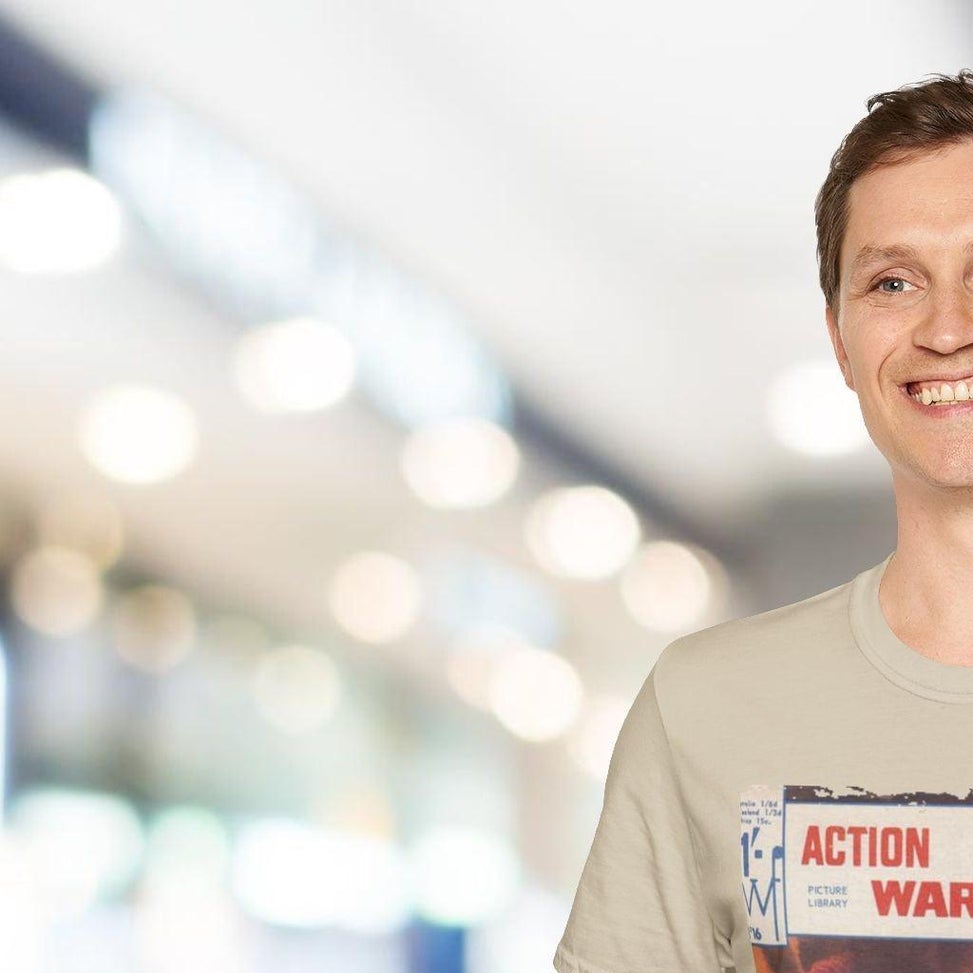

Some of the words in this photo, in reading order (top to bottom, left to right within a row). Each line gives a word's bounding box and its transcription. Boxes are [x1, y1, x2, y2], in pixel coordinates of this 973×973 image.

[801, 825, 930, 868] ACTION
[808, 885, 847, 896] PICTURE
[808, 898, 848, 908] LIBRARY
